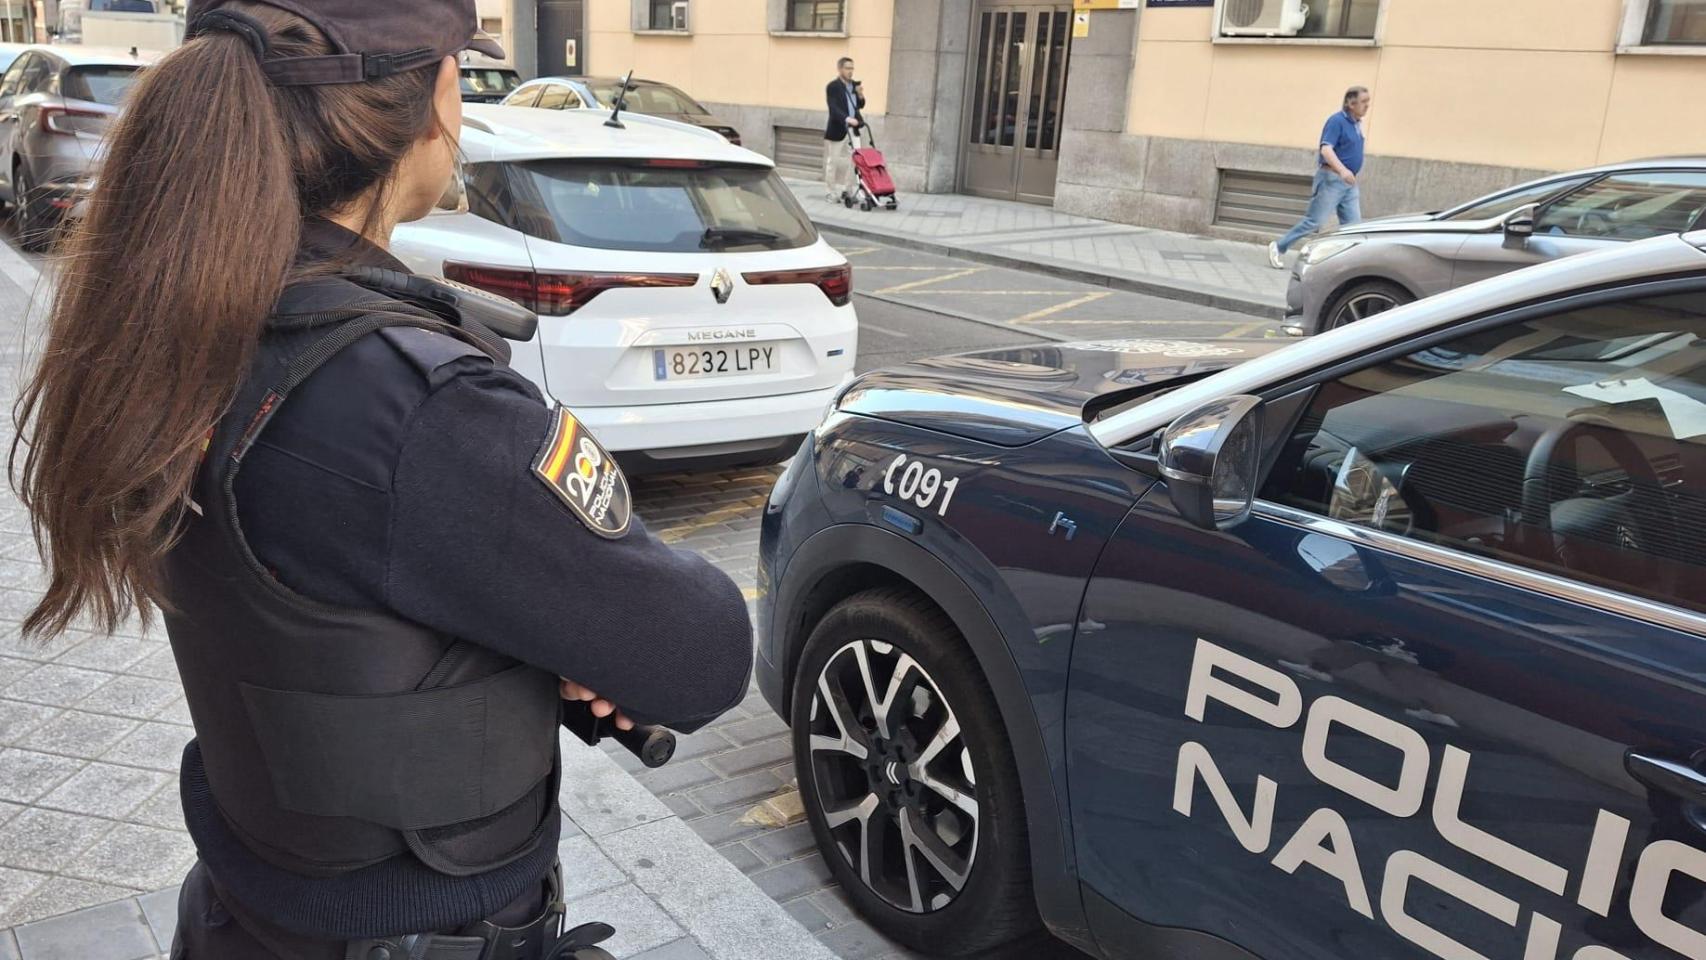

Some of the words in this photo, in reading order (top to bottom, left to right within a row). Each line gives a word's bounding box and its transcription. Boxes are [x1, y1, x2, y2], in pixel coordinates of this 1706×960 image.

[687, 329, 756, 341] MEGANE
[672, 350, 728, 375] 8232
[735, 346, 773, 371] LPY
[898, 460, 960, 517] 091
[1173, 741, 1633, 960] NAC
